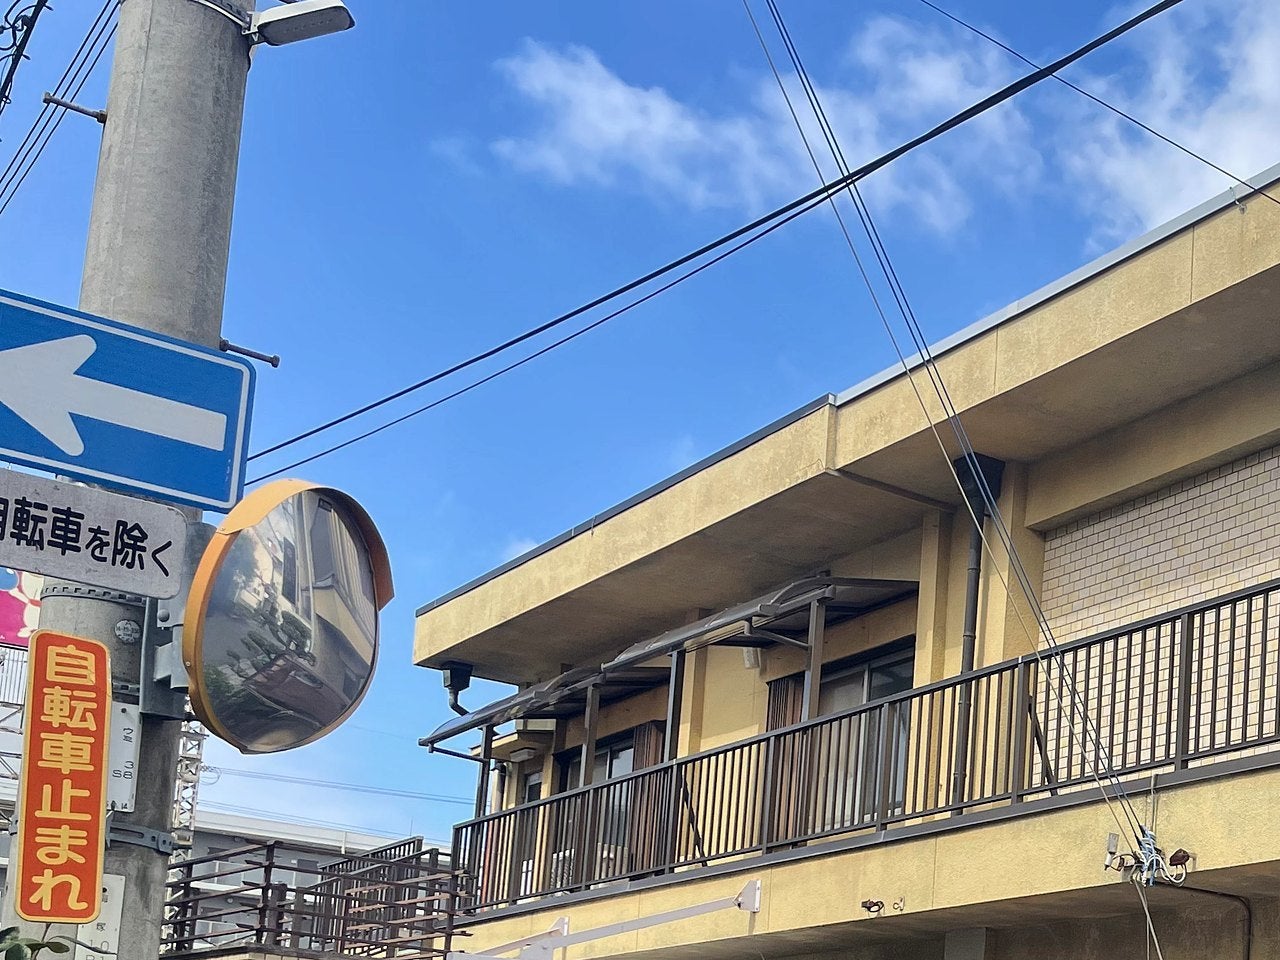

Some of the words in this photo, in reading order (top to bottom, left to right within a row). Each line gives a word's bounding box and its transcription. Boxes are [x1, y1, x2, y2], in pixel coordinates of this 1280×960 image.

[29, 644, 97, 911] 自転車止まれ
